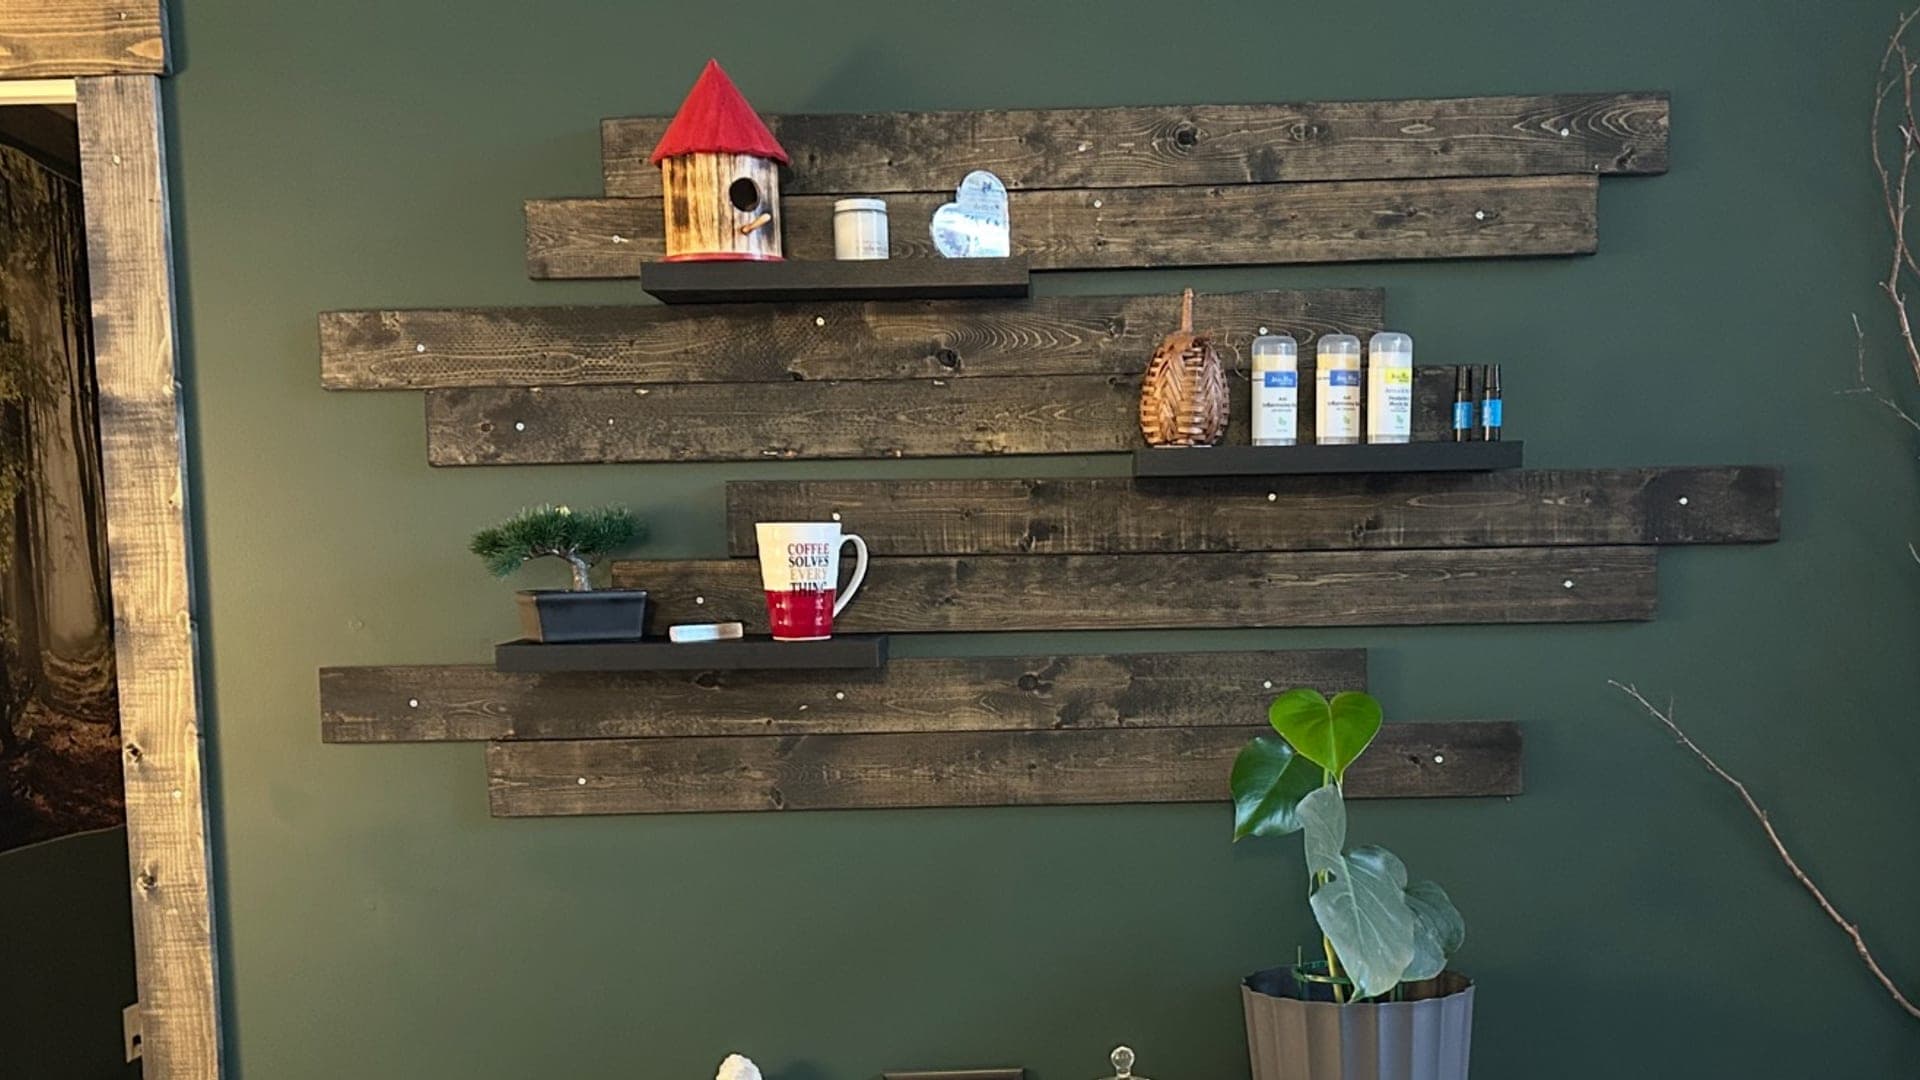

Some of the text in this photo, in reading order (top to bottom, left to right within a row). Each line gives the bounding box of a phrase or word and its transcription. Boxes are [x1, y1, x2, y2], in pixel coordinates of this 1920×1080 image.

[787, 543, 829, 555] COFFEE
[788, 555, 829, 568] SOLVES
[790, 568, 827, 580] EVERY
